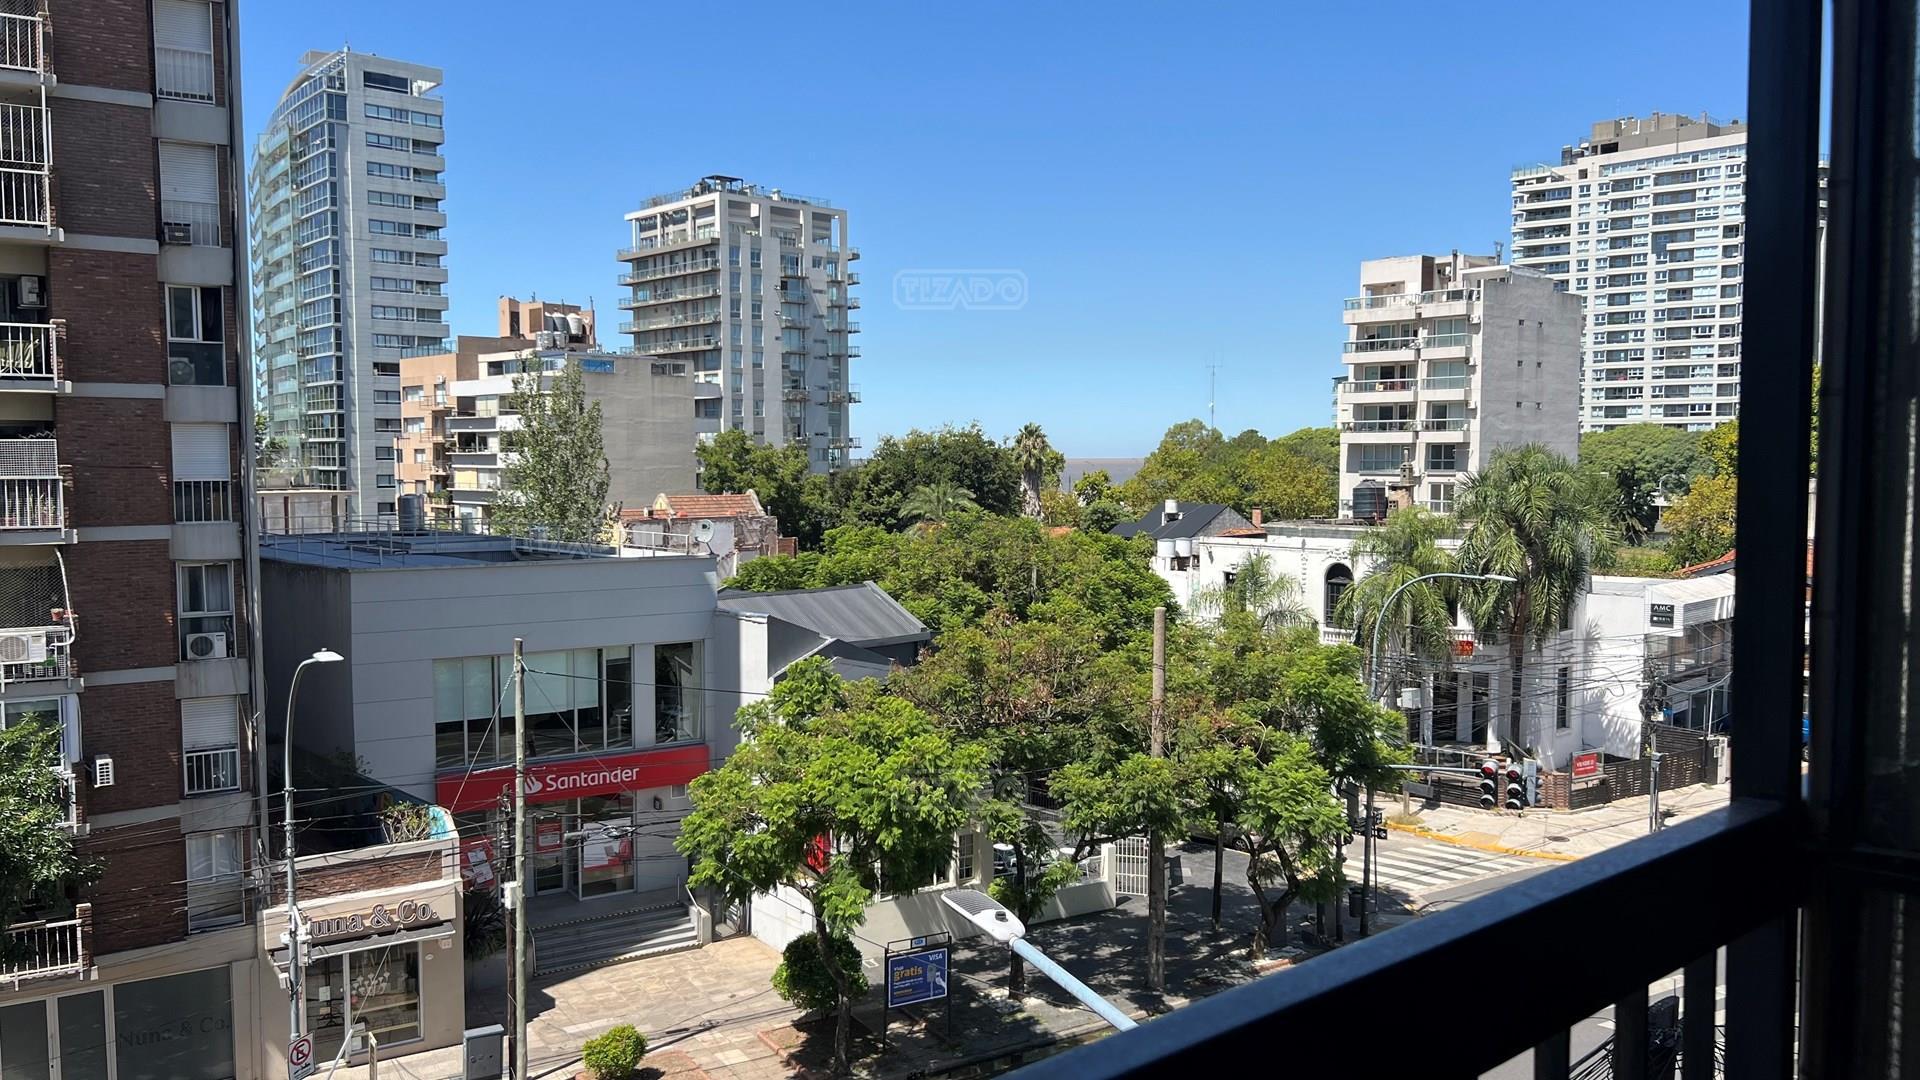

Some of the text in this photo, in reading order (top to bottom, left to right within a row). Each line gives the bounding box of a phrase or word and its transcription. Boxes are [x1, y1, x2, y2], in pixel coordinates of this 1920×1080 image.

[546, 767, 640, 791] Santander
[310, 899, 438, 938] una & Co.
[928, 953, 943, 961] VISA
[894, 965, 923, 981] gratis
